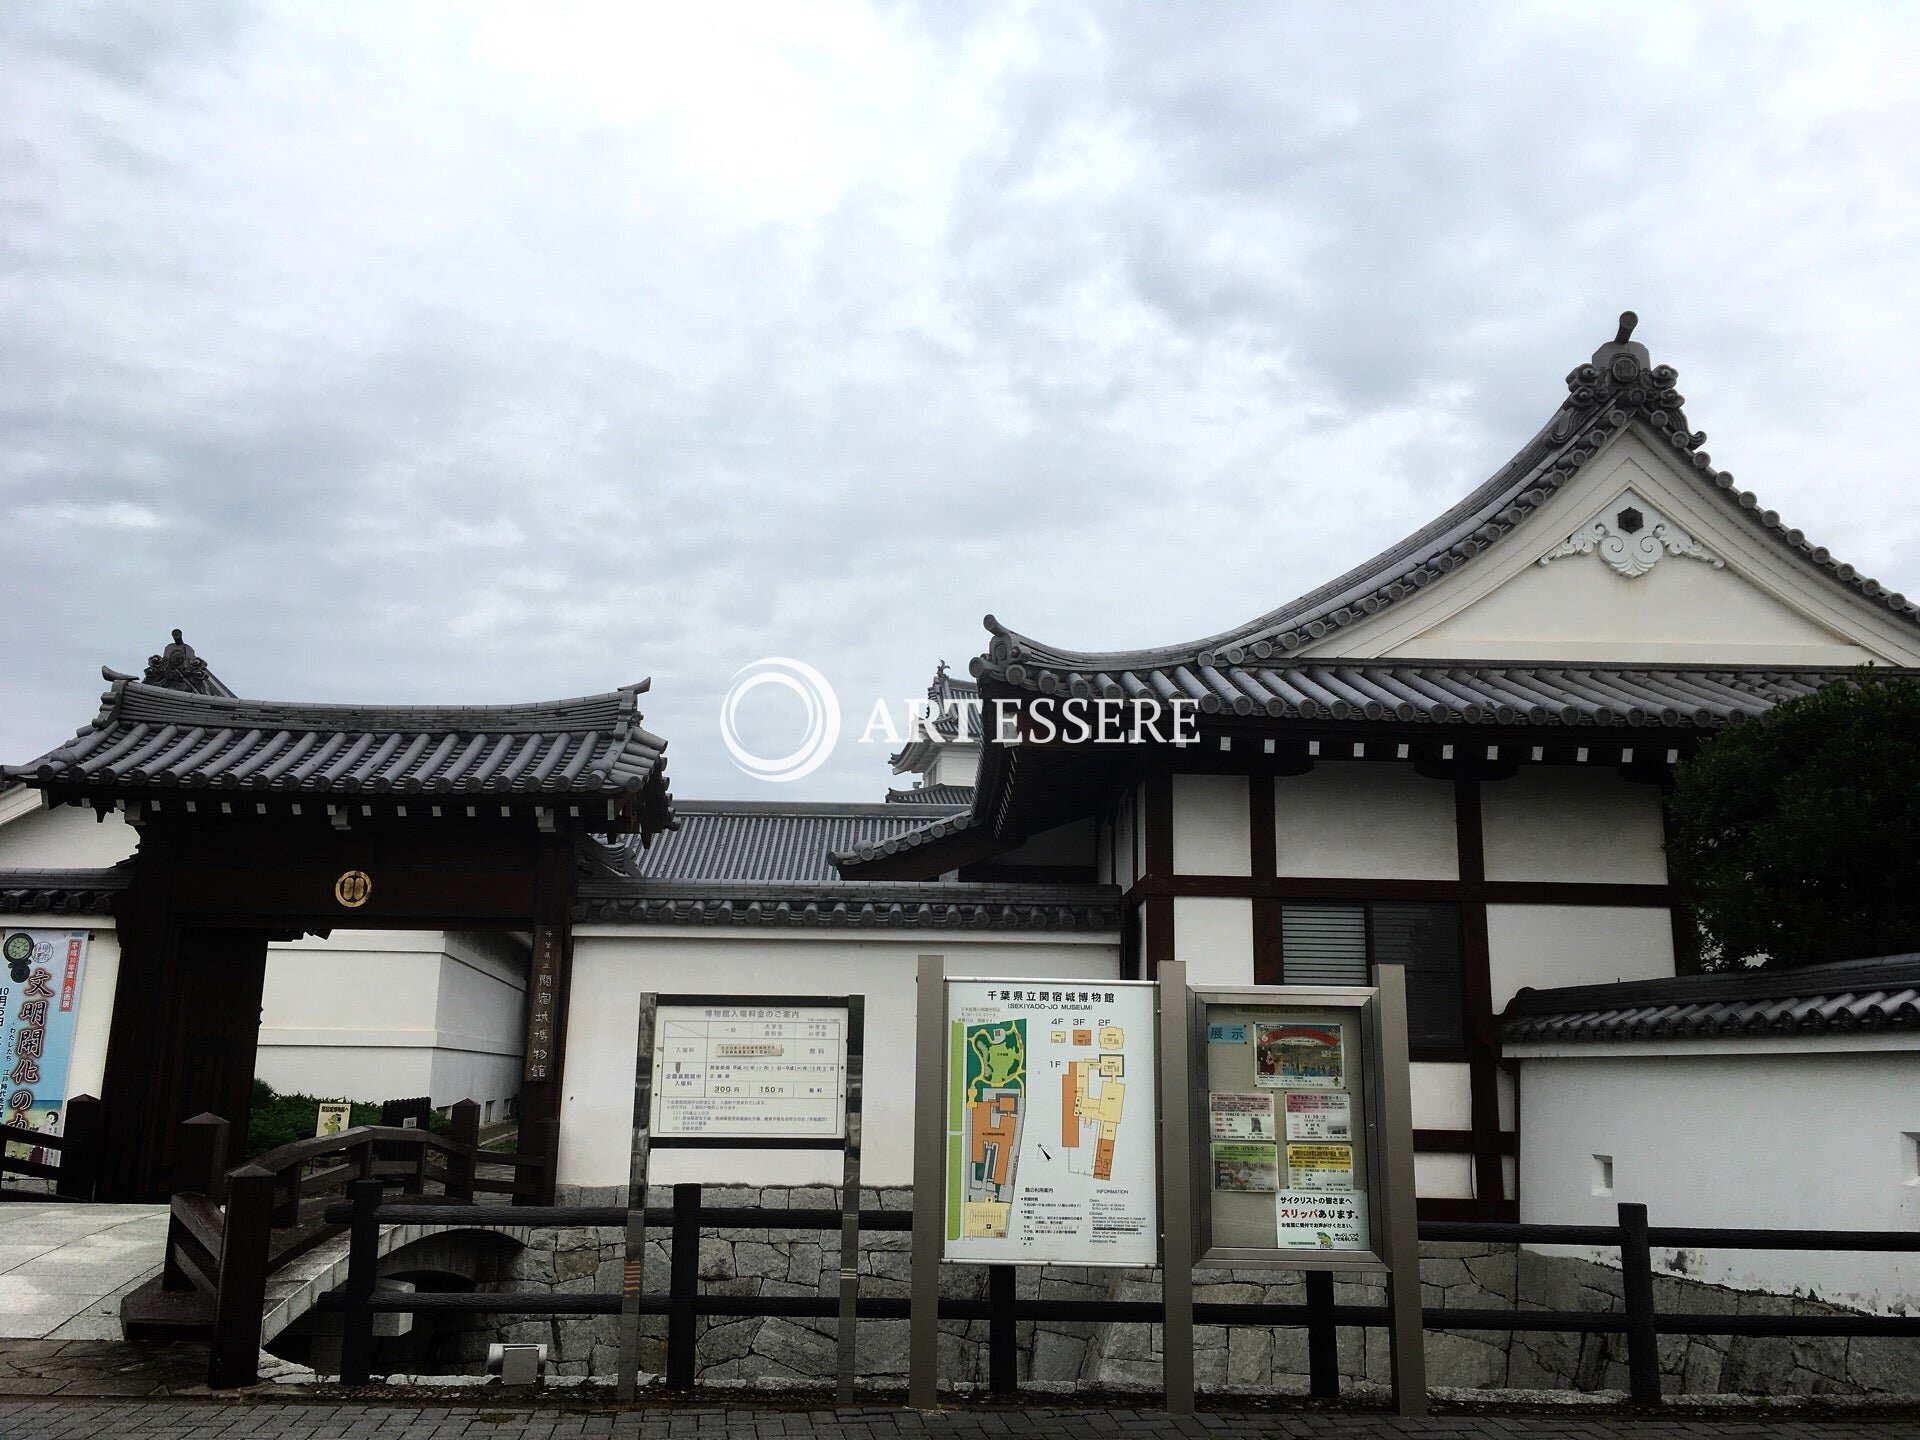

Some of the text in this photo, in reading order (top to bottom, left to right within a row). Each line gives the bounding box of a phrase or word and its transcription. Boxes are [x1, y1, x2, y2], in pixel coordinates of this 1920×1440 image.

[987, 990, 1115, 1003] 千葉県立関宿城博物館
[1061, 1003, 1093, 1011] MUSEUM)
[1072, 1018, 1085, 1026] 3F
[1050, 1060, 1061, 1068] 1F
[1280, 1196, 1353, 1204] サイクリストの皆さまへ
[1281, 1208, 1359, 1219] スリッパあります。
